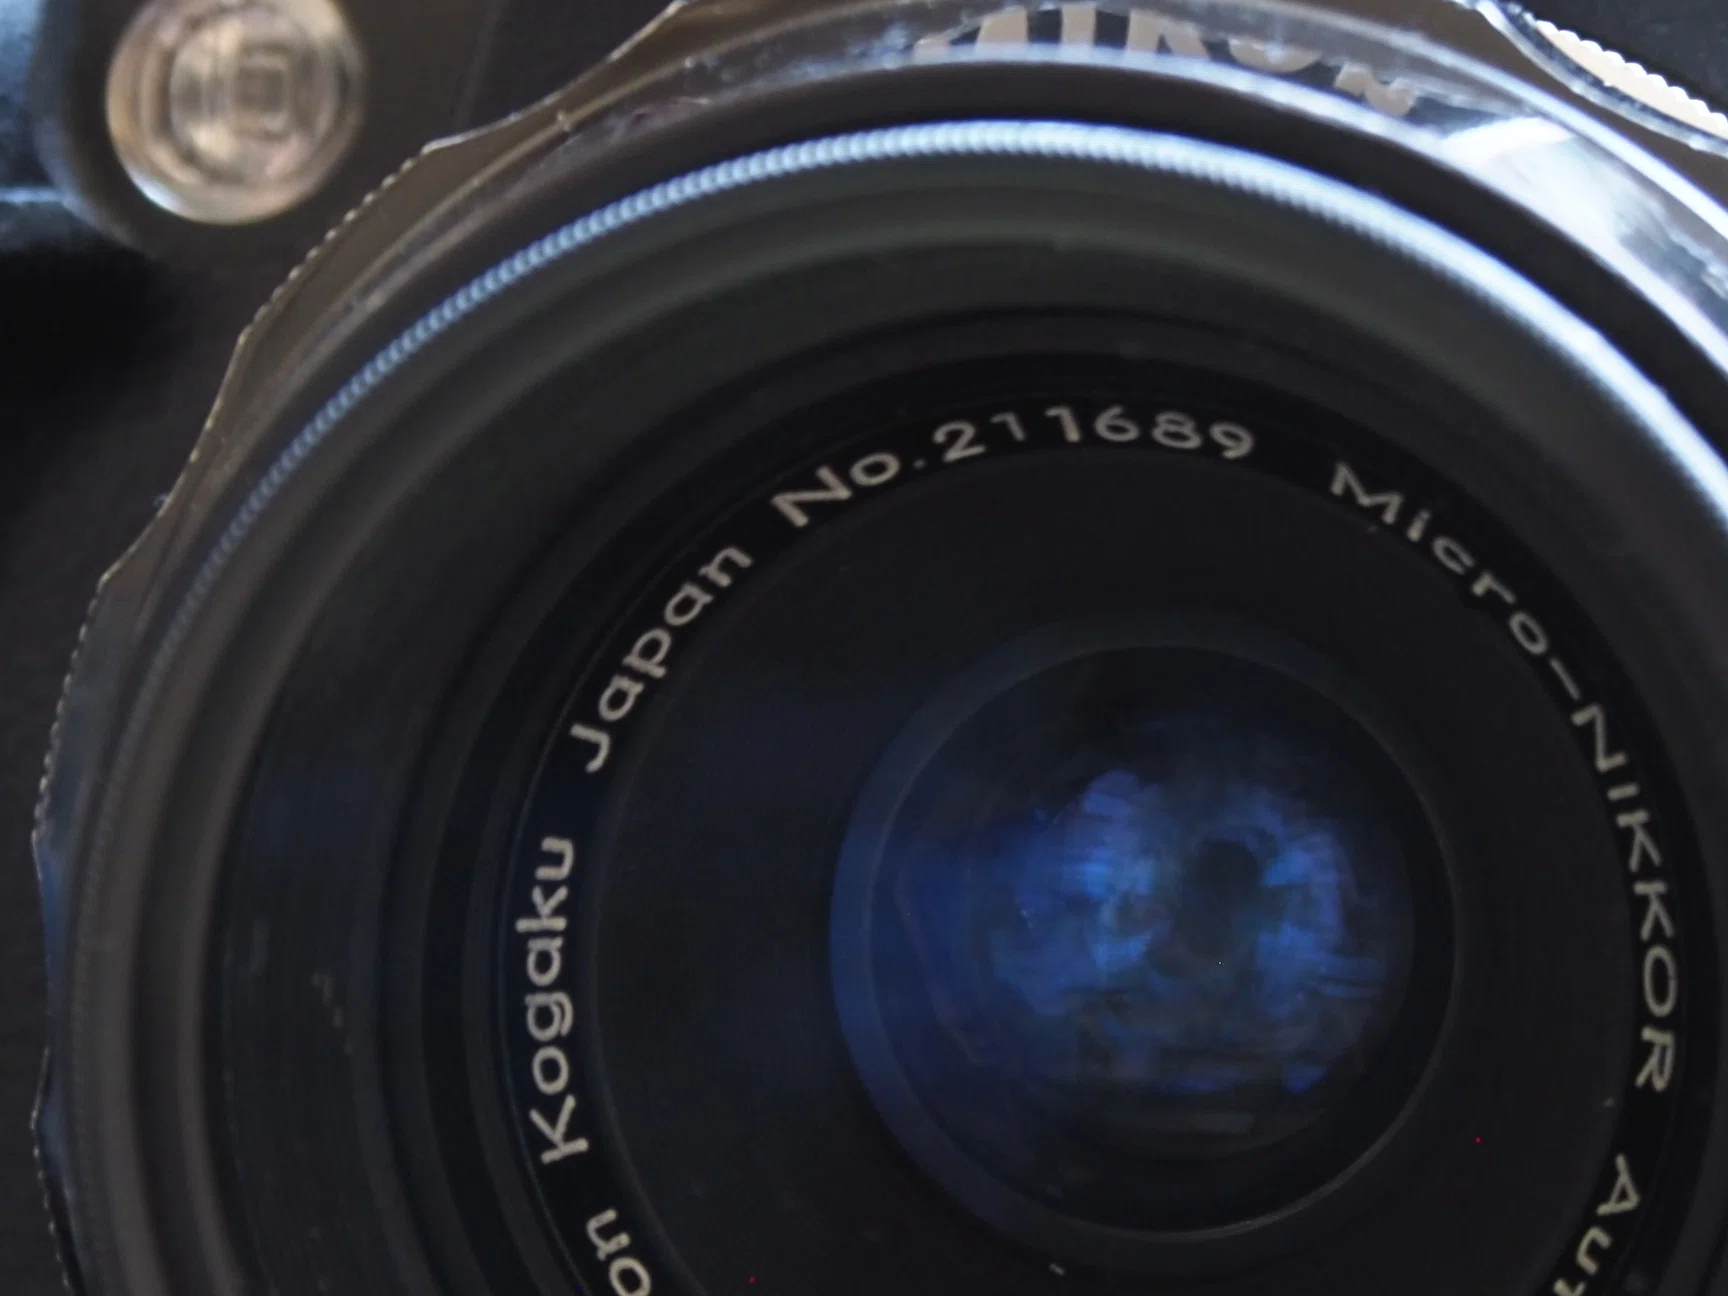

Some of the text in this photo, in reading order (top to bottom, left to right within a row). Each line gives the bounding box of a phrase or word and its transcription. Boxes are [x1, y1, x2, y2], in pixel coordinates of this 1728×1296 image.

[514, 835, 587, 1165] Kogaku
[569, 546, 753, 774] Japan
[771, 406, 1254, 528] No.211689
[1330, 463, 1677, 1092] Micro-NIKKOR
